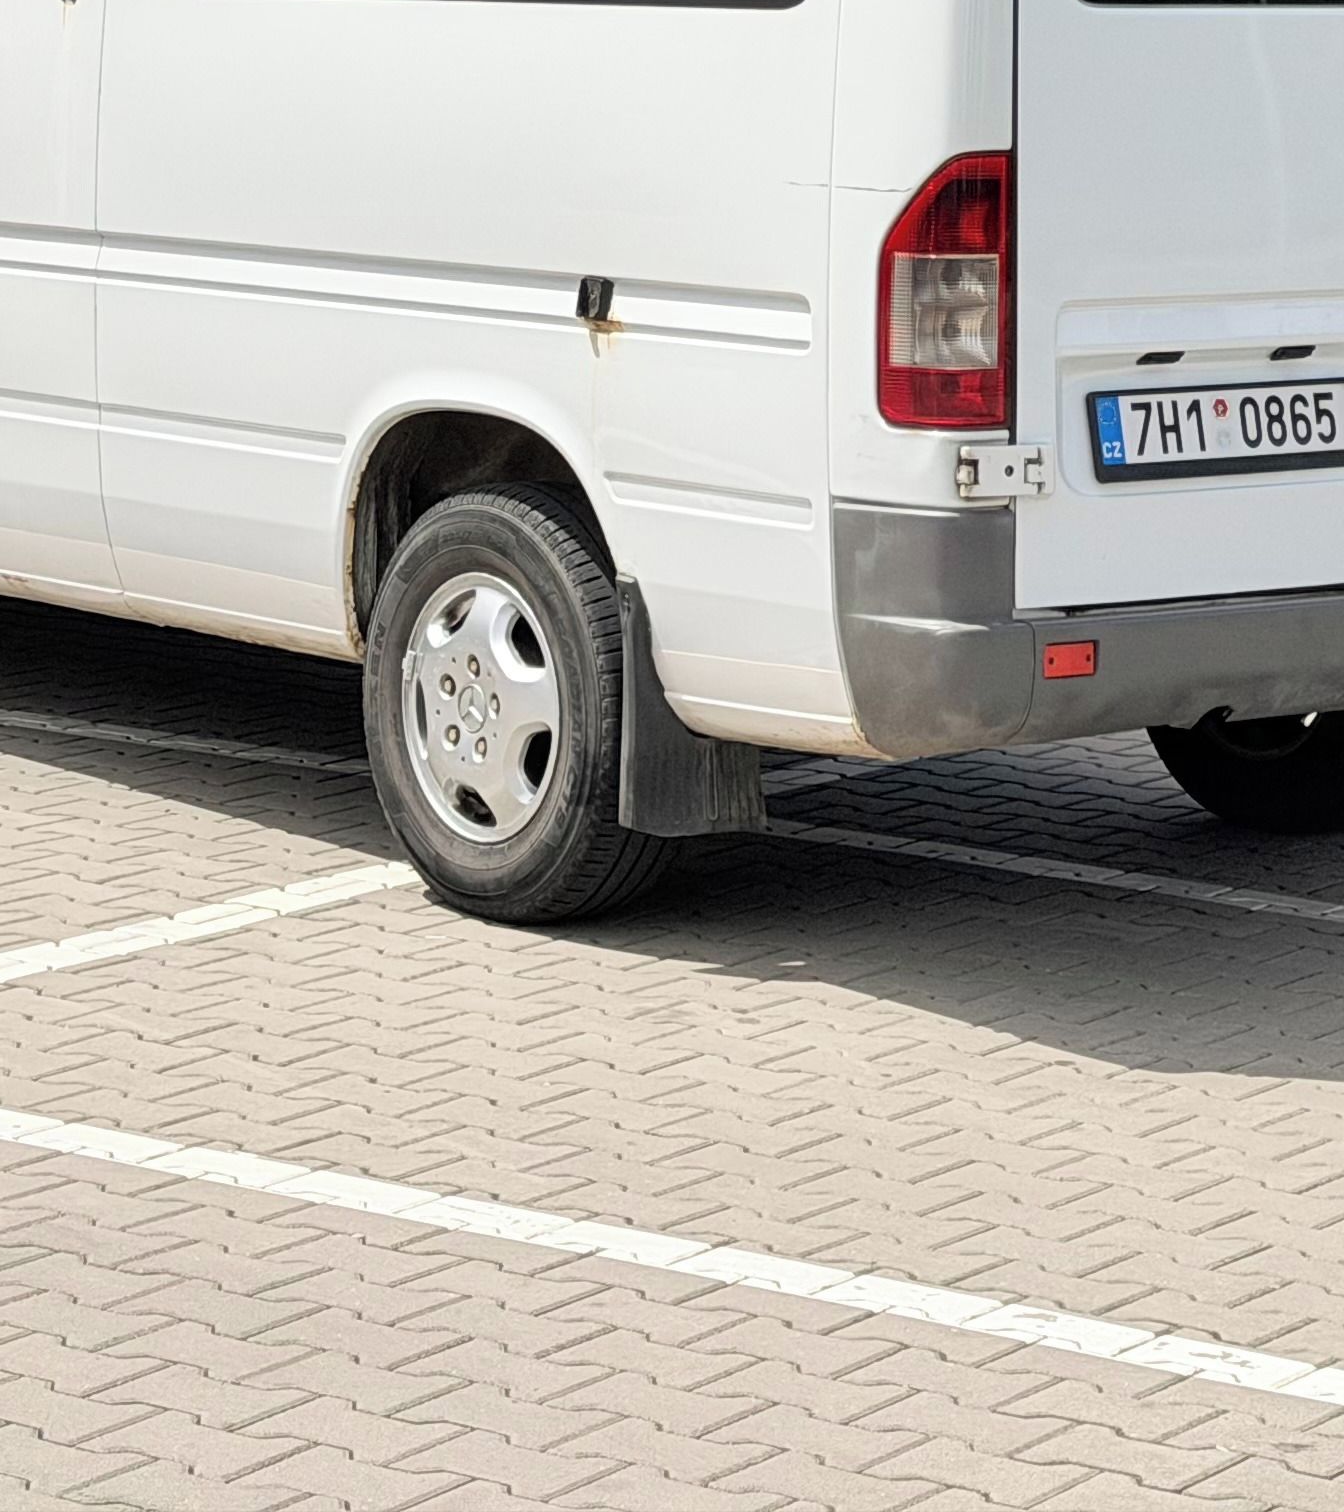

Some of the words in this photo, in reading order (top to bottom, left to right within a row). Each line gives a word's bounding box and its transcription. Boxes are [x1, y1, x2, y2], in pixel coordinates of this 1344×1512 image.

[1130, 398, 1206, 456] 7H1
[1239, 392, 1337, 448] 0865
[1102, 441, 1123, 458] CZ
